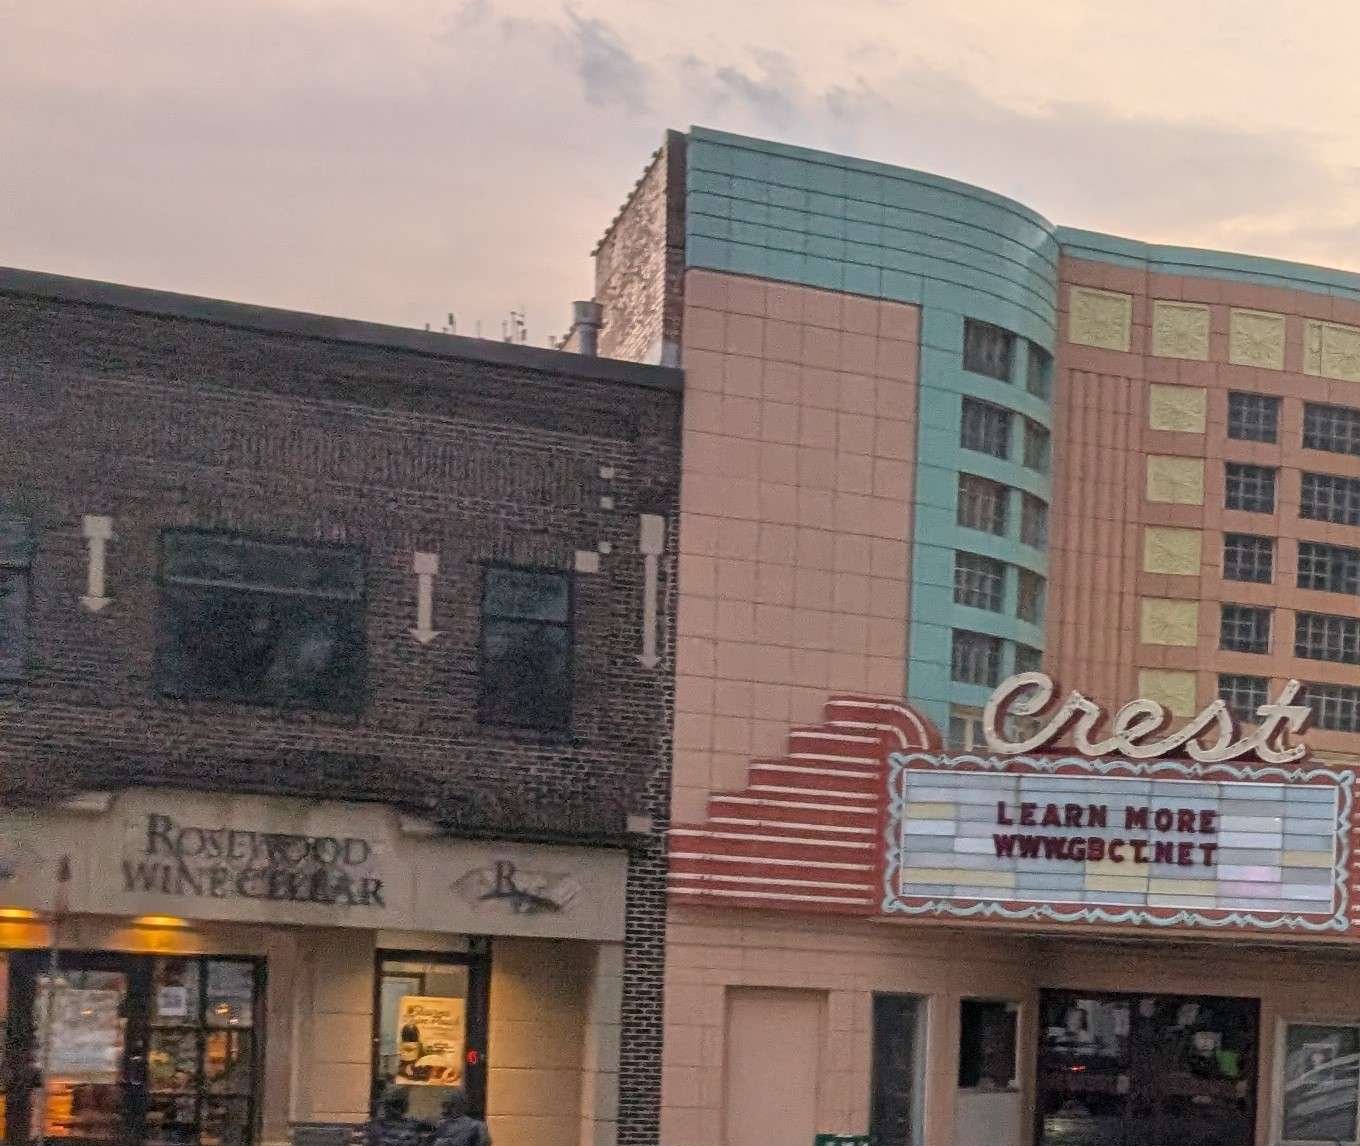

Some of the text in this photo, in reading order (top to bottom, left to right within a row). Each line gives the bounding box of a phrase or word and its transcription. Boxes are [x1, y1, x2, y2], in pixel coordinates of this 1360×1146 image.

[984, 672, 1312, 764] Crest
[997, 801, 1217, 834] LEARN MORE
